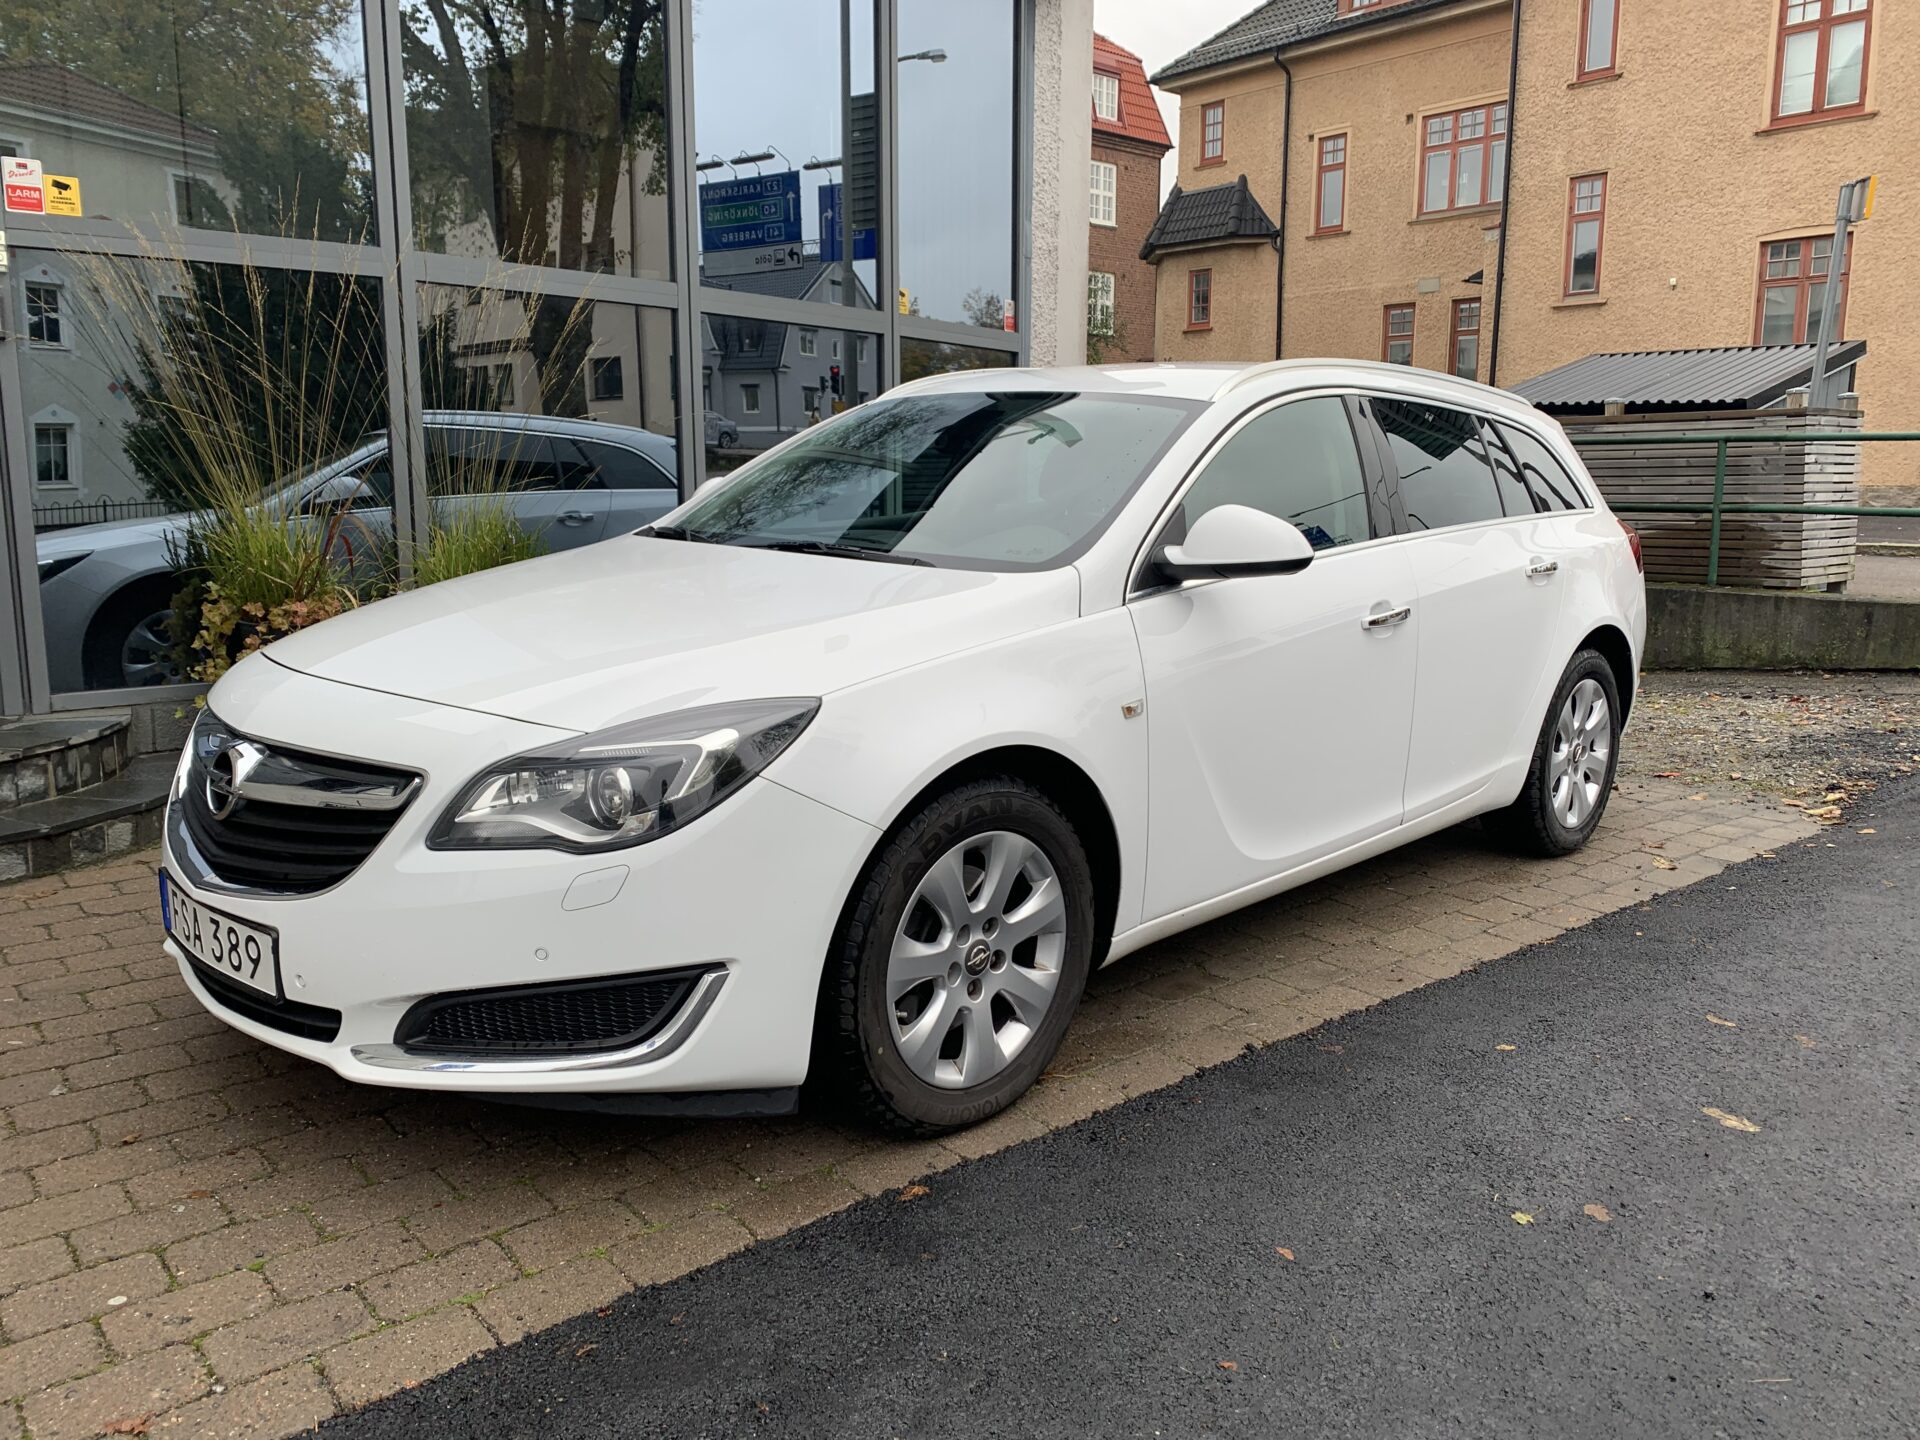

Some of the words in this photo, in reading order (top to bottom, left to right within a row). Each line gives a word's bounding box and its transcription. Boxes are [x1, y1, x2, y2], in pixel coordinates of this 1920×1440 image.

[8, 187, 40, 199] LARM
[901, 798, 1013, 892] ADVAN
[171, 888, 204, 954] FSA
[209, 916, 261, 979] 389
